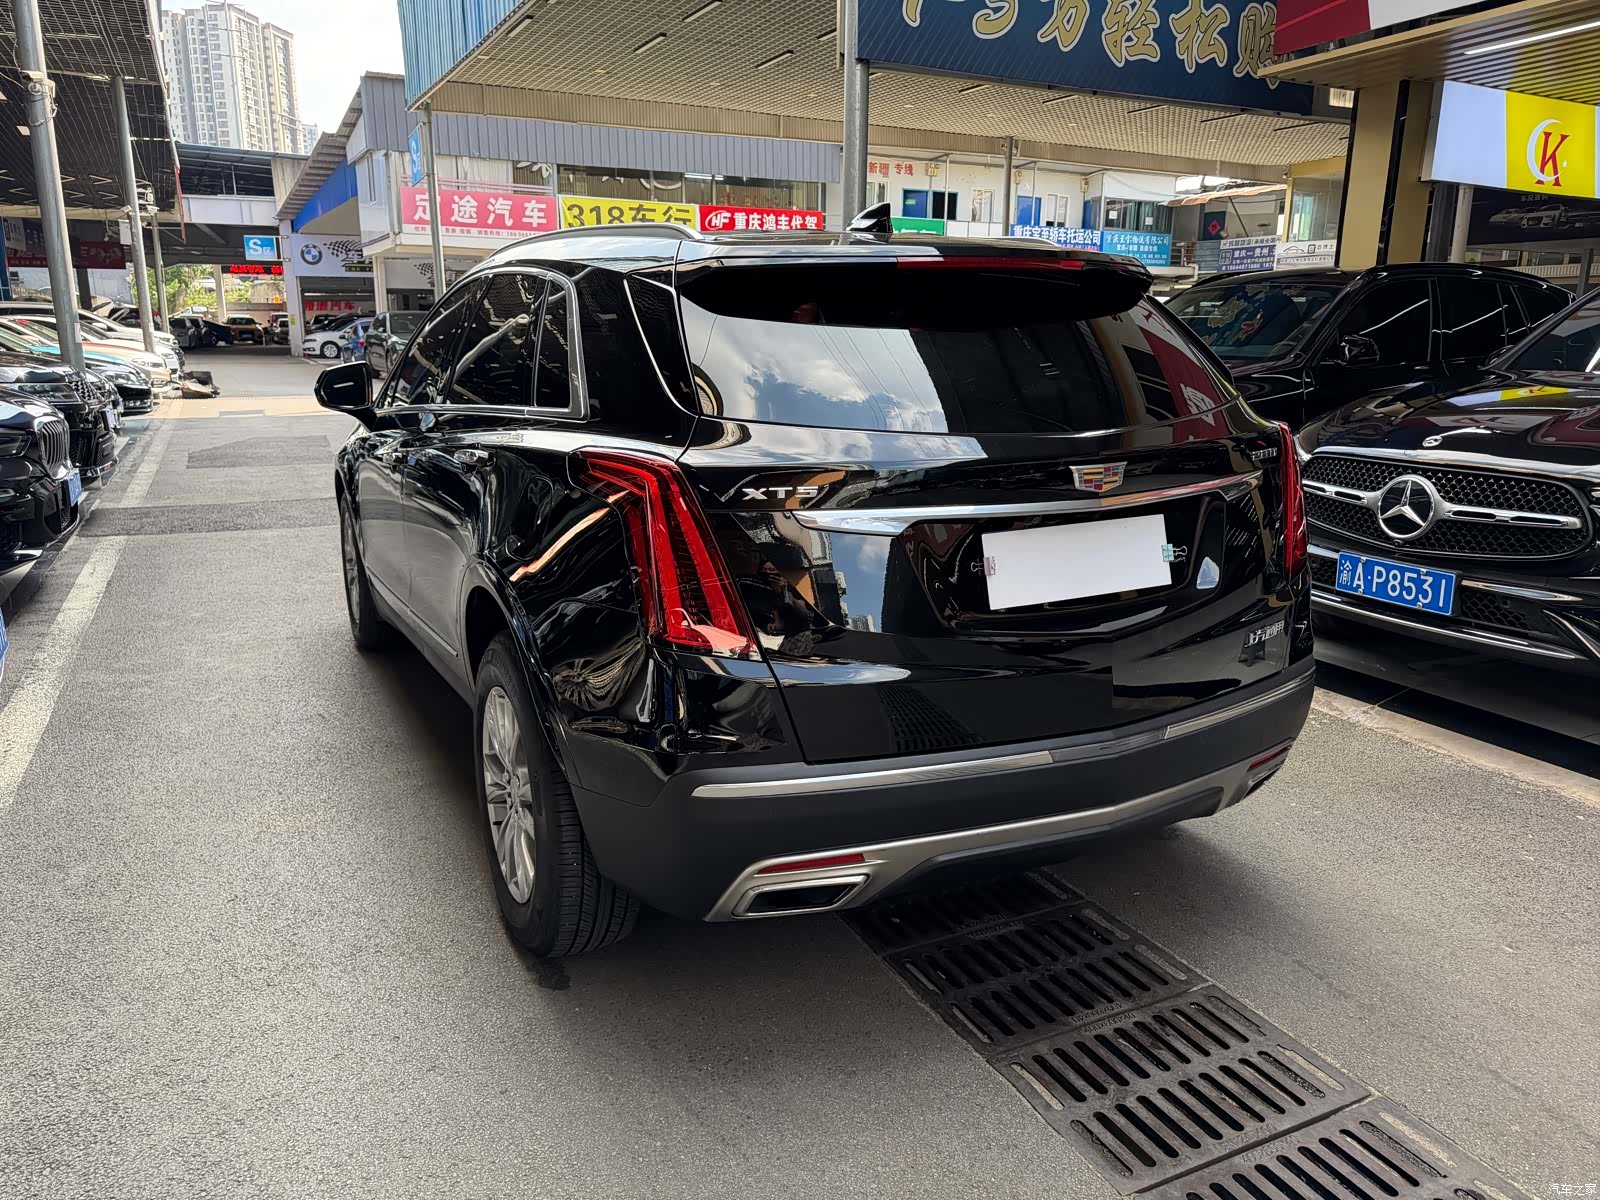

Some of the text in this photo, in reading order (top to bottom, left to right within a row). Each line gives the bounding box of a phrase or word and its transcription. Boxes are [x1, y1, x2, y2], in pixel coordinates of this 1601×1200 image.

[733, 211, 818, 231] 重庆鸿丰代驾
[742, 486, 819, 501] XT5
[1339, 559, 1446, 608] 渝A·P8531
